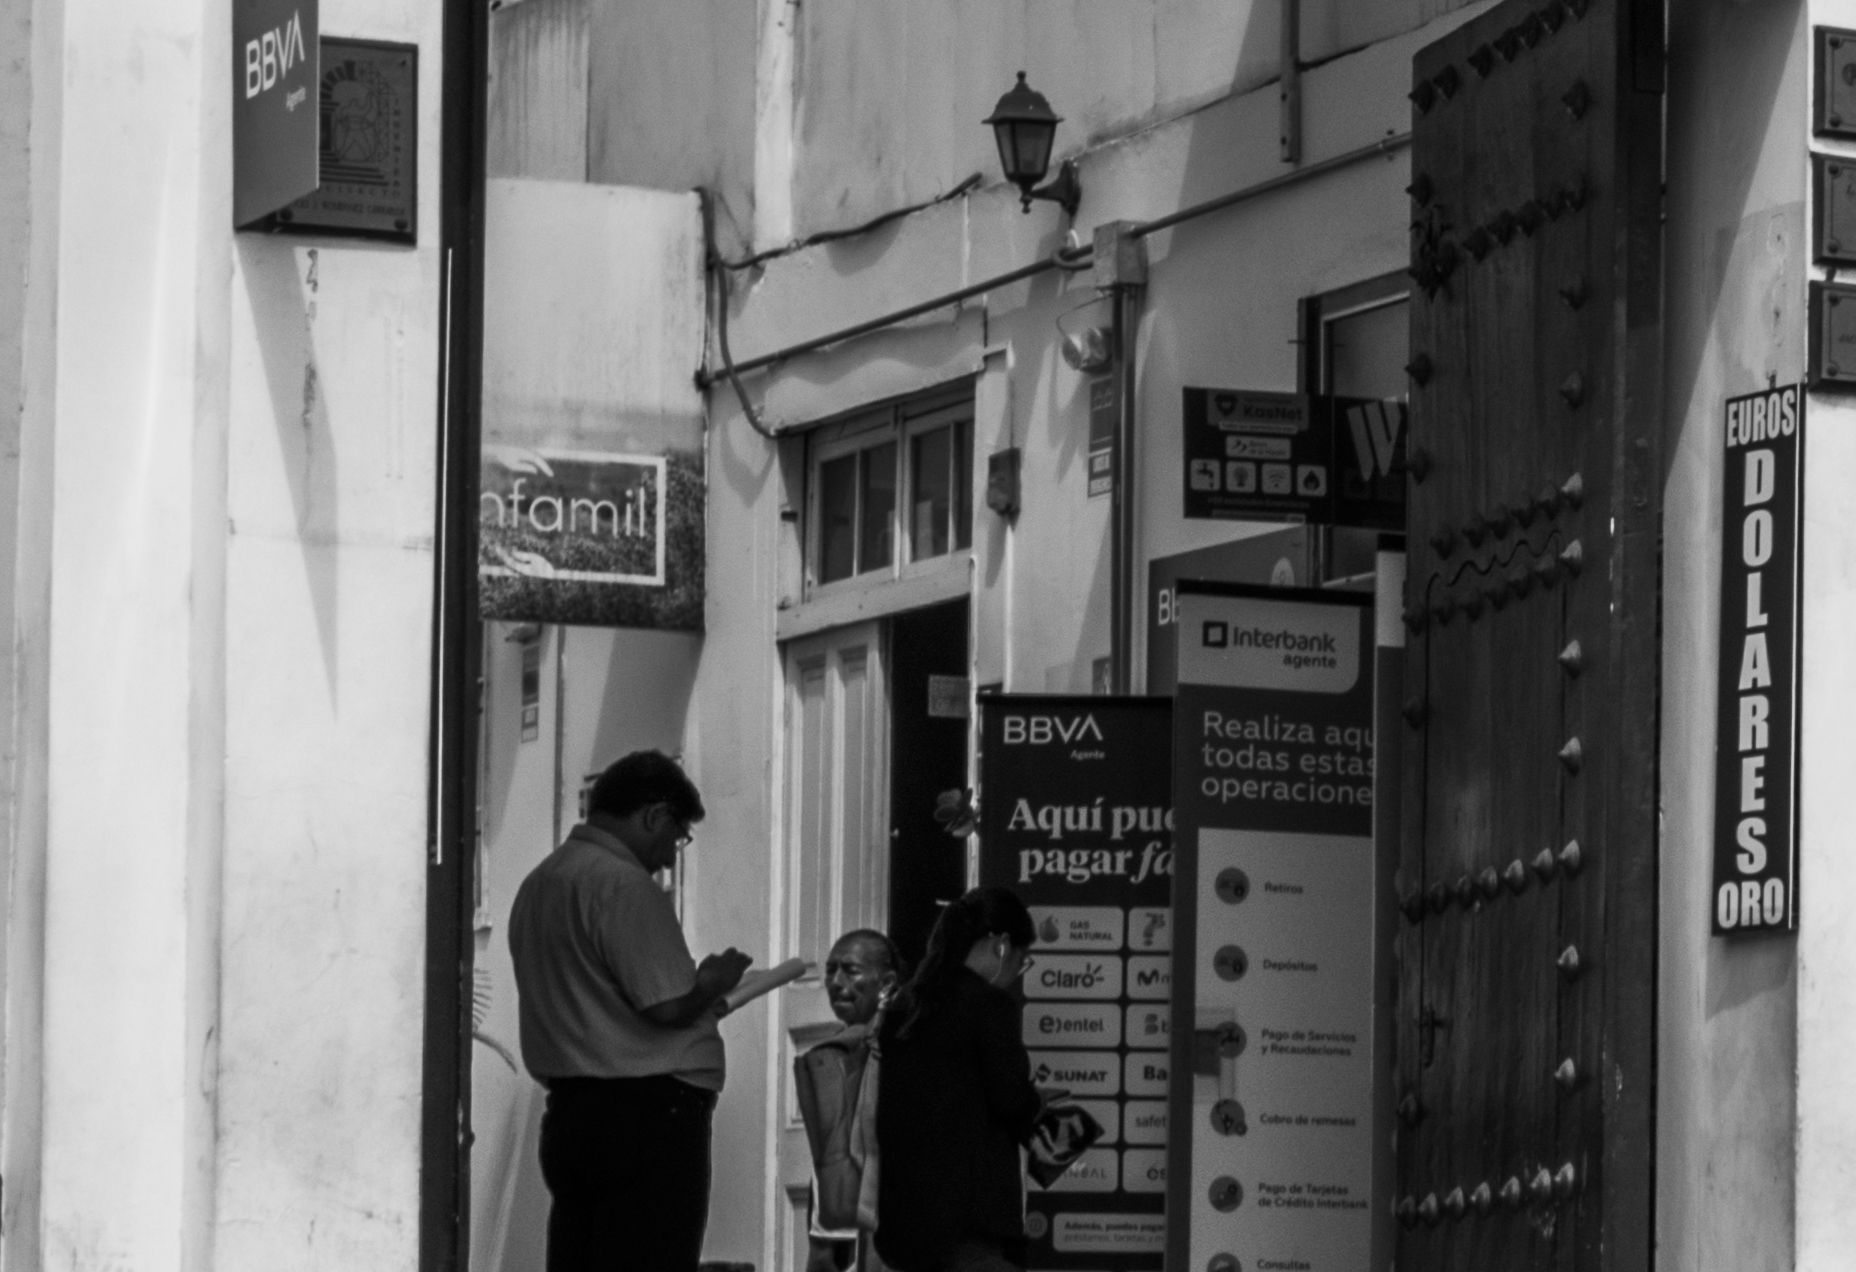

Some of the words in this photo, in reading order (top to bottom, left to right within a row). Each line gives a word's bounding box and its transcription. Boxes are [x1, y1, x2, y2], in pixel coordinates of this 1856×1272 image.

[245, 9, 306, 100] BBVA
[1726, 390, 1797, 448] EUROS
[1233, 626, 1337, 653] Interbank
[1283, 653, 1338, 669] agente
[1735, 447, 1777, 875] DOLARES
[1003, 713, 1104, 744] BBVA
[1202, 709, 1317, 745] Realiza
[1201, 740, 1291, 772] todas
[1006, 795, 1106, 841] Aquí
[1018, 847, 1133, 884] pagar
[1717, 877, 1785, 930] ORO
[1041, 966, 1096, 989] Claro
[1053, 1069, 1109, 1083] SUNAT
